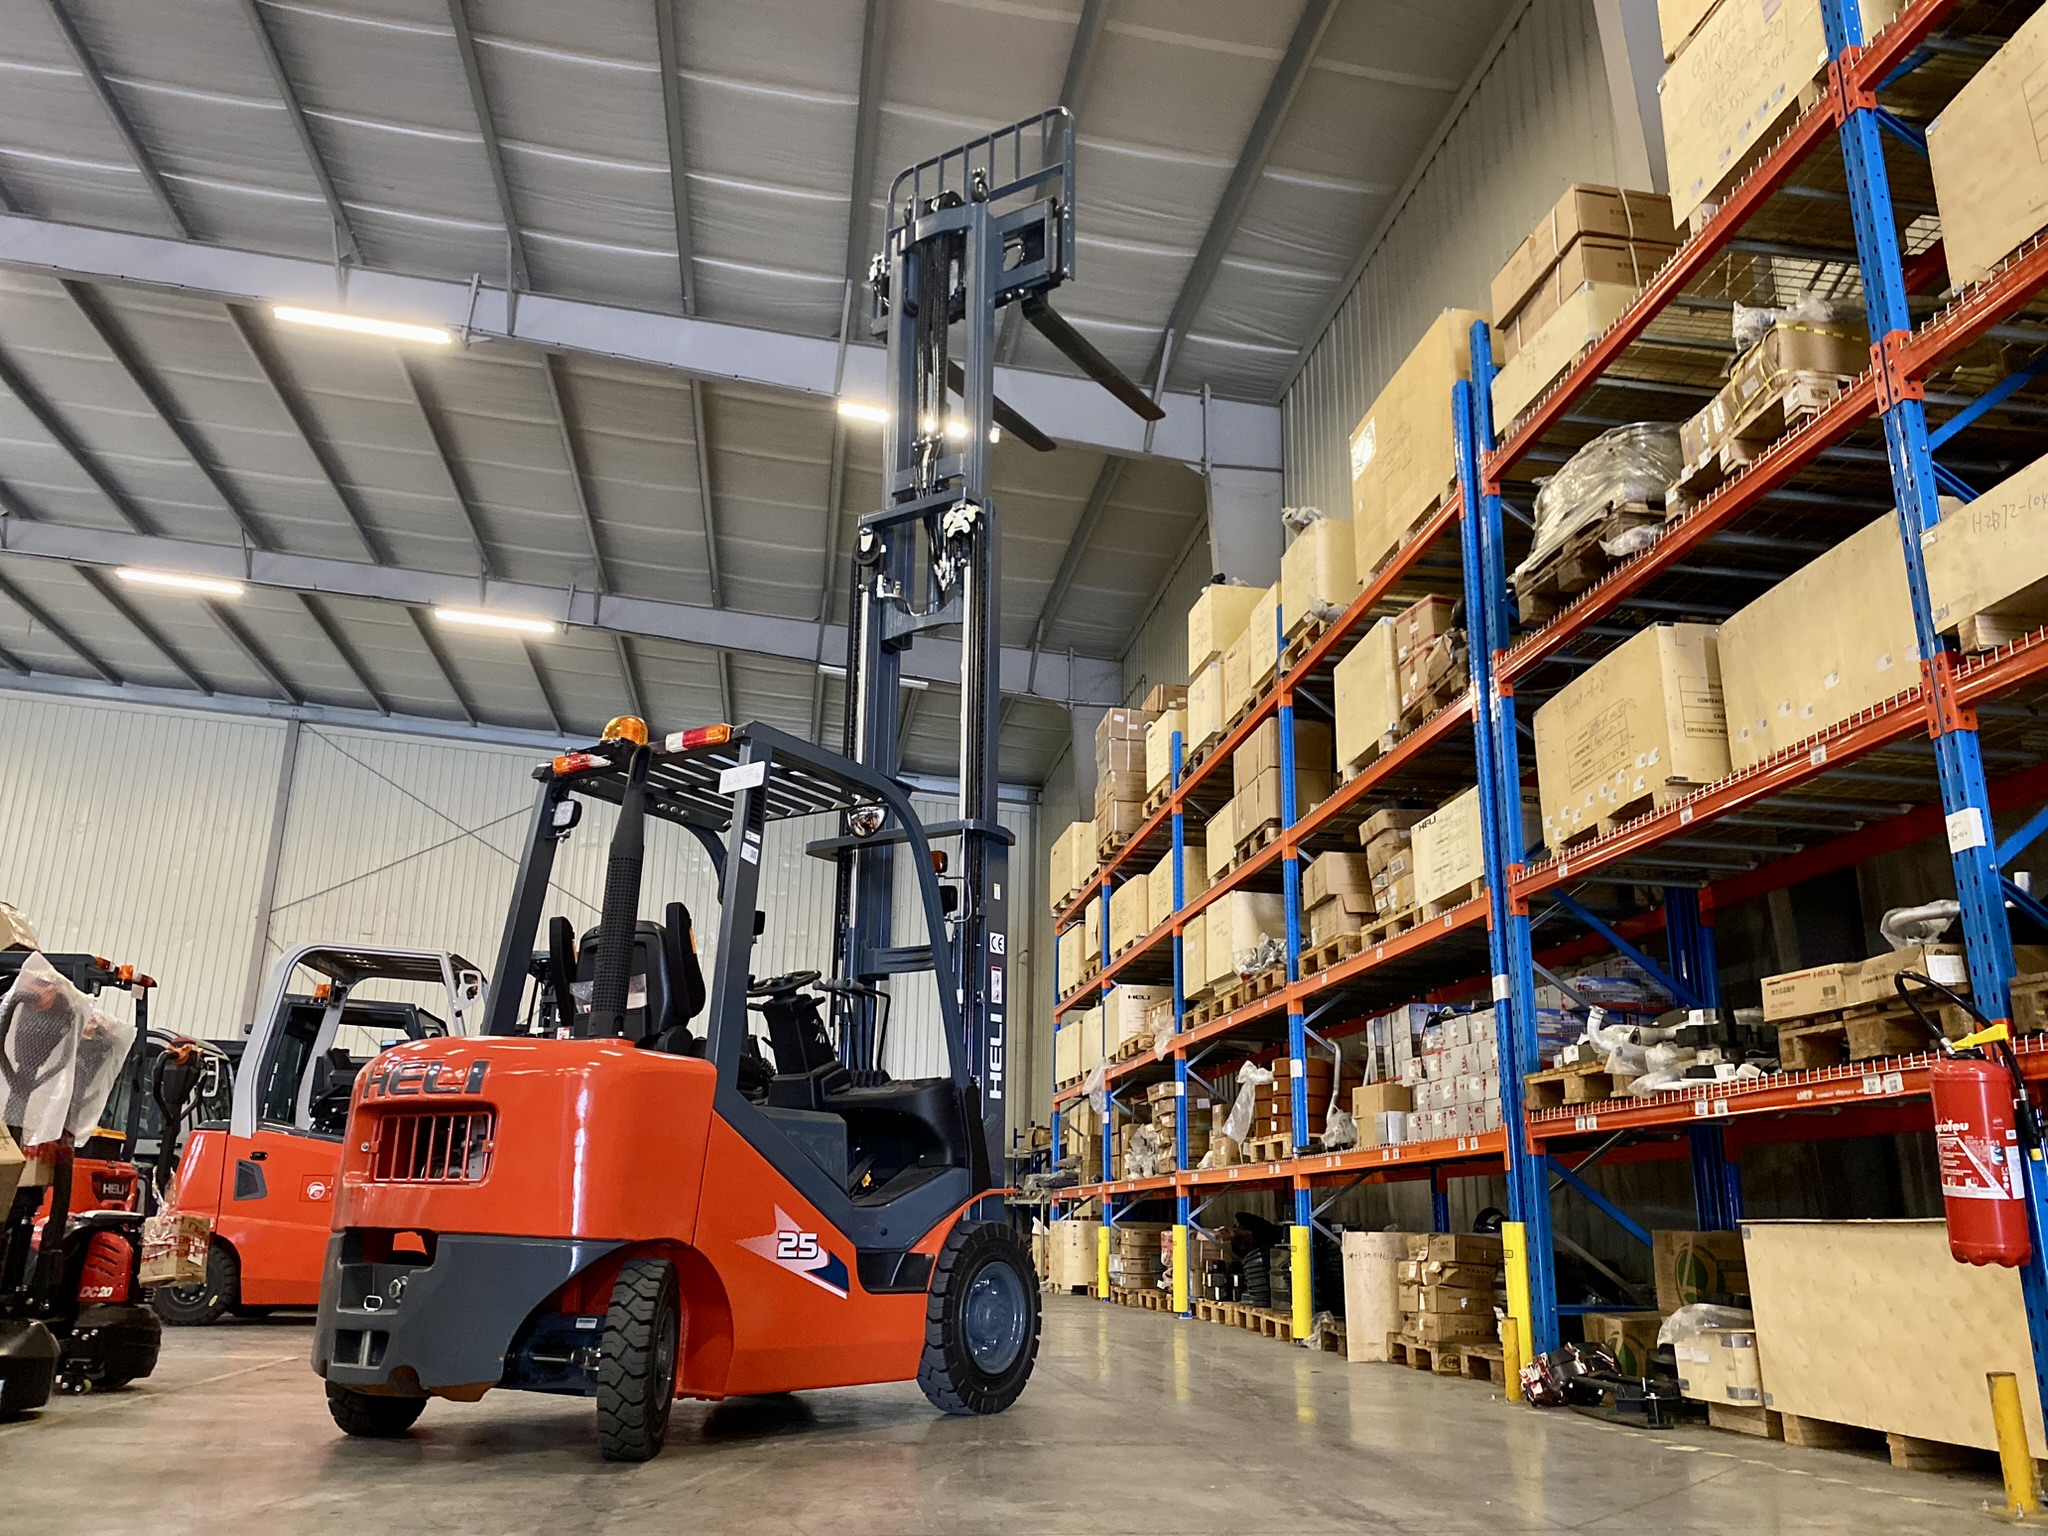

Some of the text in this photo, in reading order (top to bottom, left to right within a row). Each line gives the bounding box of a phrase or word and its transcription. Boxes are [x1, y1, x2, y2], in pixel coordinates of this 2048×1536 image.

[1972, 492, 2048, 534] H2B72-104
[1418, 816, 1436, 832] HELI
[1813, 968, 1836, 979] HELI
[989, 1013, 1003, 1099] HELI
[363, 1060, 490, 1098] HELI
[102, 1183, 125, 1195] HELI
[777, 1231, 819, 1259] 25
